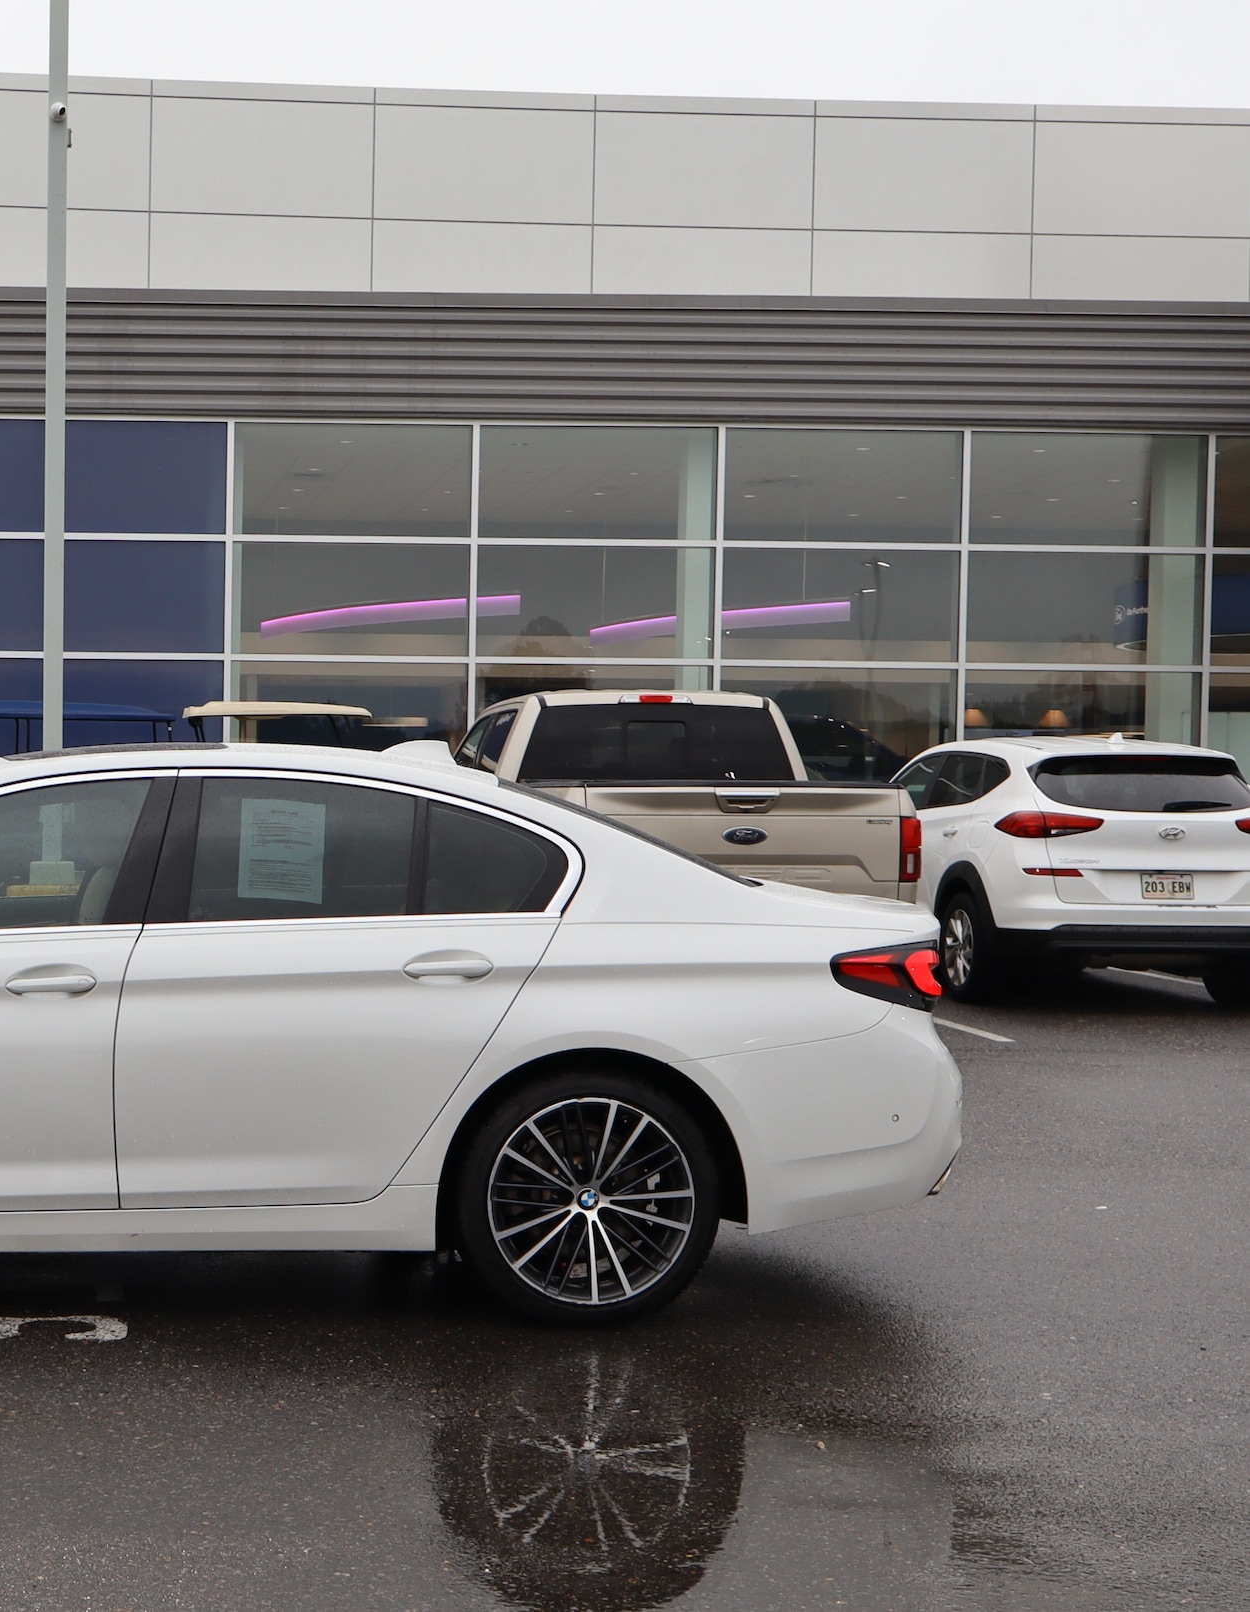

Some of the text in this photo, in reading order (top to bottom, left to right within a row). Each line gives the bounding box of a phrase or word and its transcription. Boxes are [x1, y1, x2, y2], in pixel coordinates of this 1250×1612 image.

[733, 829, 758, 841] Ford
[1144, 881, 1191, 893] 203 EBW
